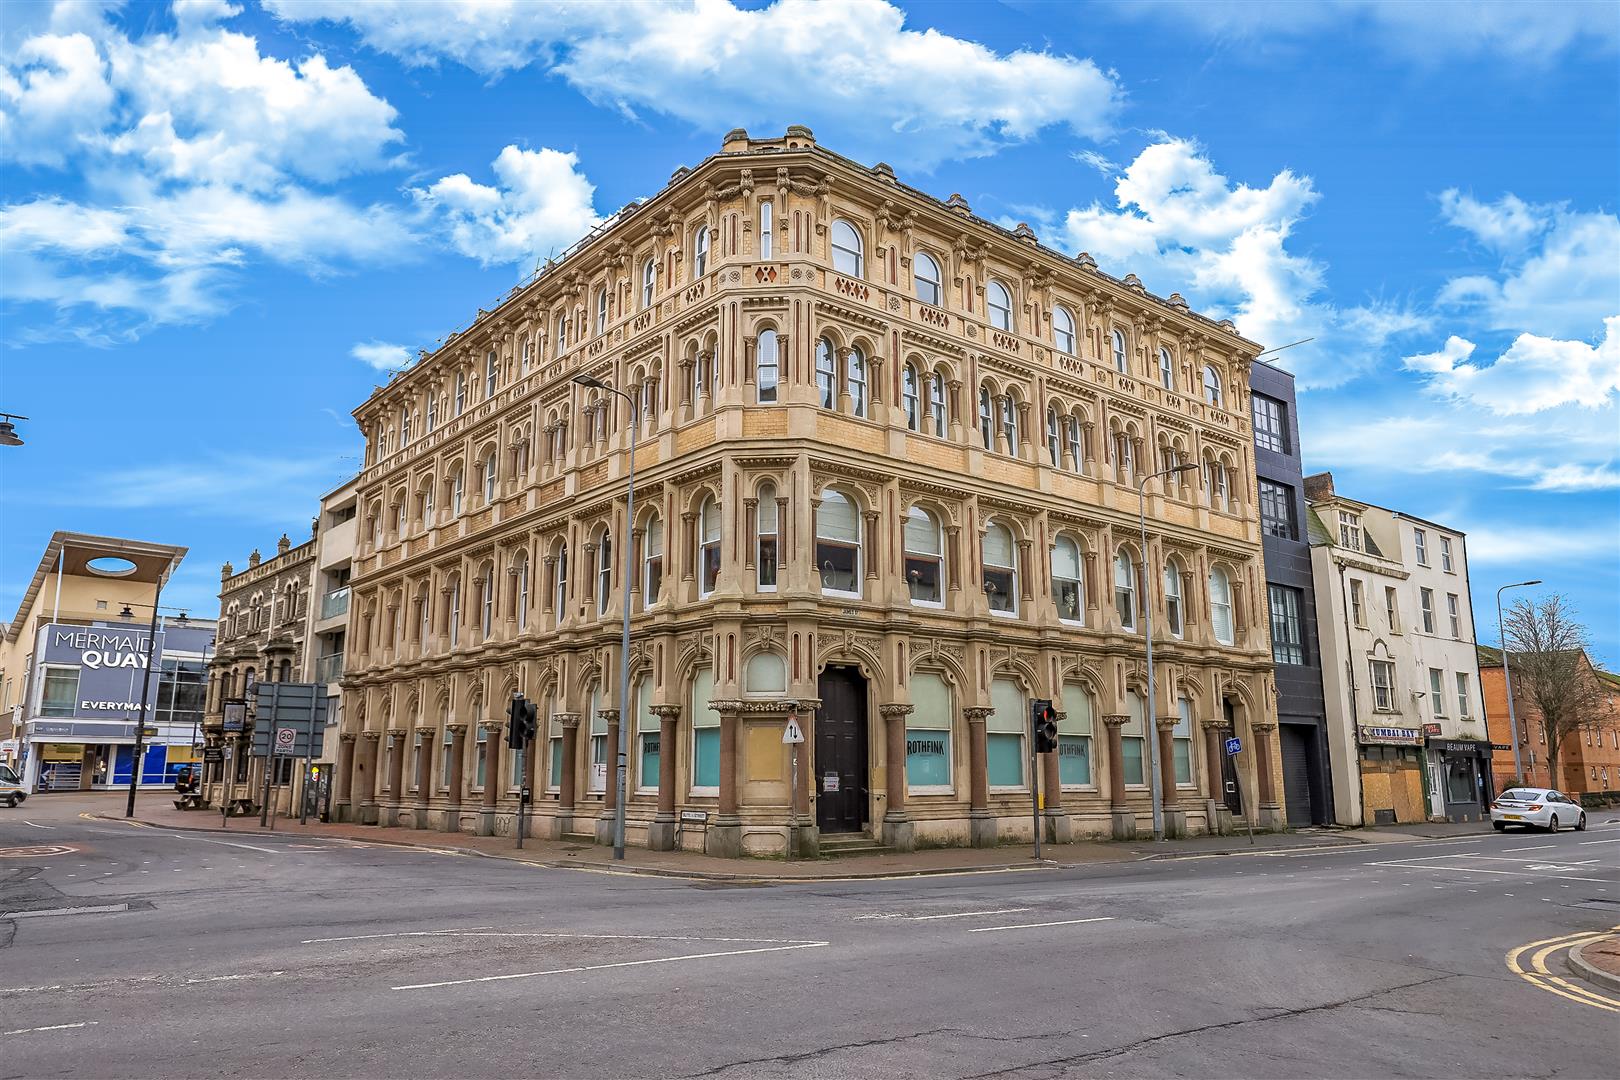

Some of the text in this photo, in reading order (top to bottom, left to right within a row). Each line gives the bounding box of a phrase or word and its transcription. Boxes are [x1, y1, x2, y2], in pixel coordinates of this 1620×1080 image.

[55, 632, 156, 653] MERMAID
[81, 650, 154, 669] QUAY
[81, 701, 151, 712] EVERYMAN
[907, 740, 945, 756] ROTHFINK
